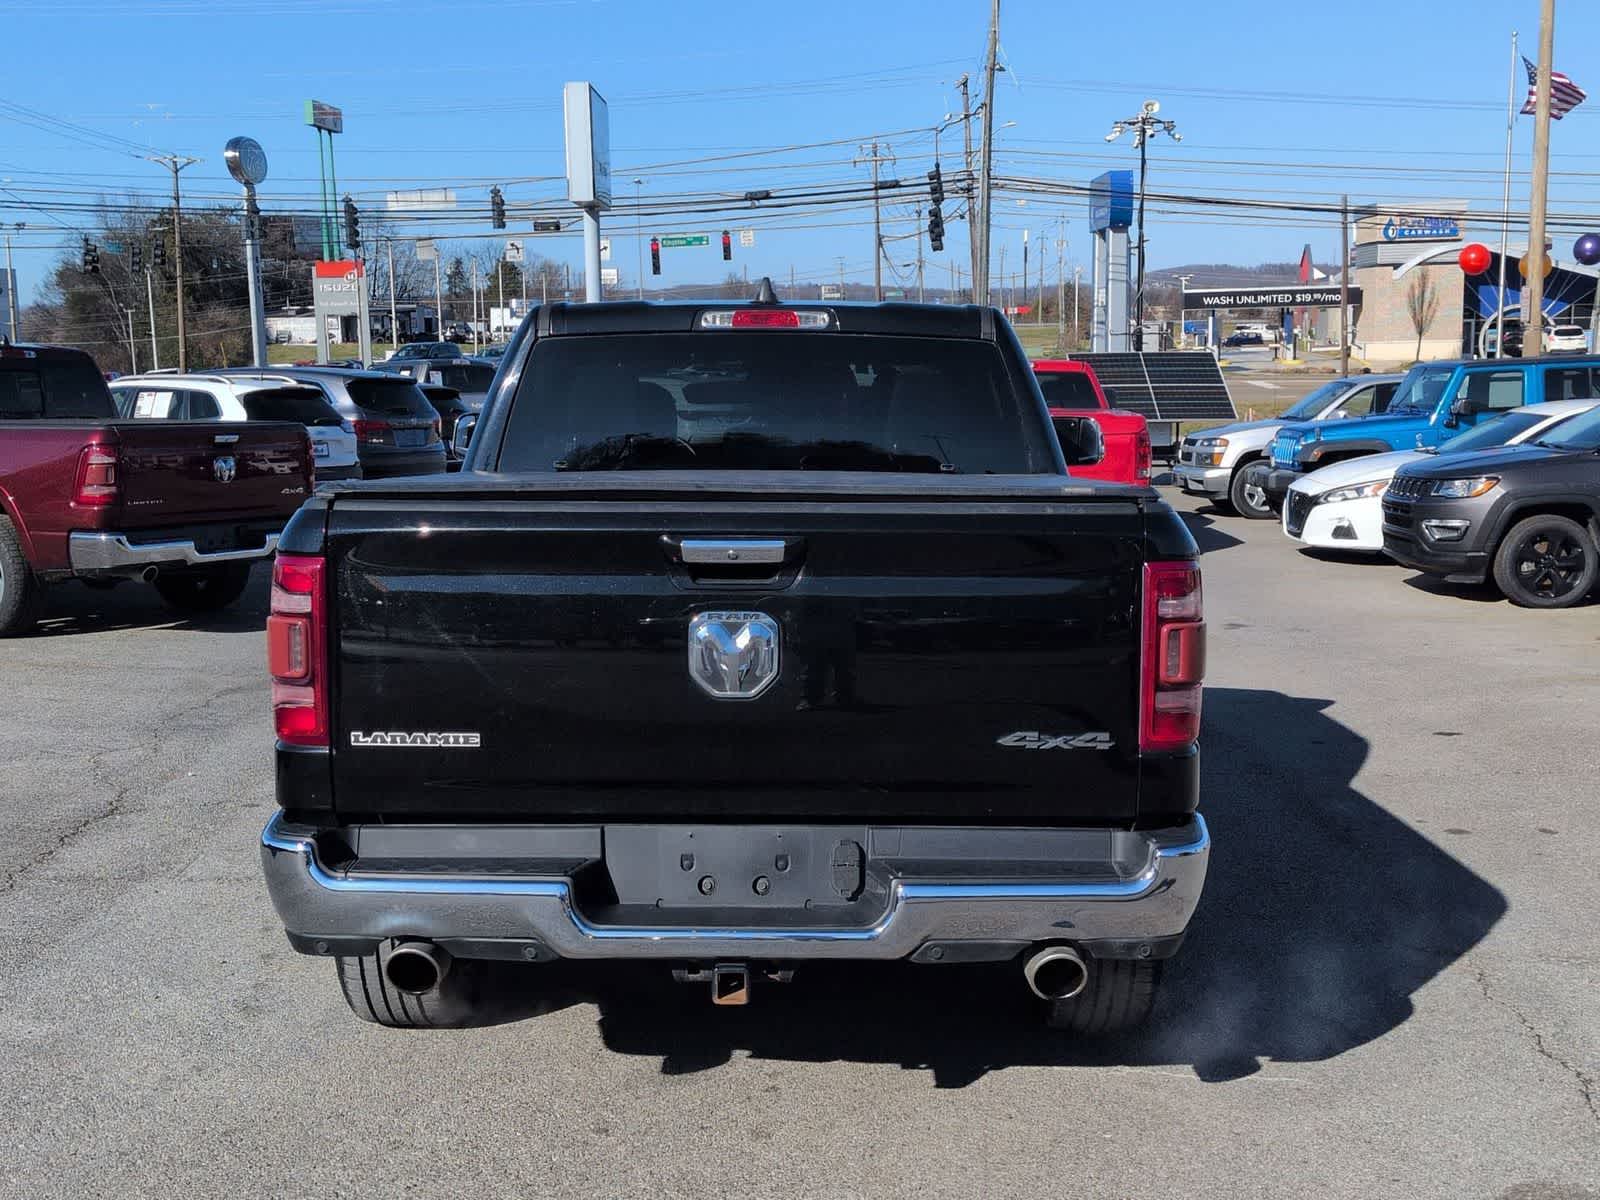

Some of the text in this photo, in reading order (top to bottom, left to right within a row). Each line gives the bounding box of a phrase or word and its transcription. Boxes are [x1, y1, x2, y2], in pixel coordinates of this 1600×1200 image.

[1203, 295, 1234, 305] WASH
[1236, 293, 1293, 304] UNLIMITED
[350, 731, 481, 748] LARAMIE
[996, 731, 1116, 750] 4x4
